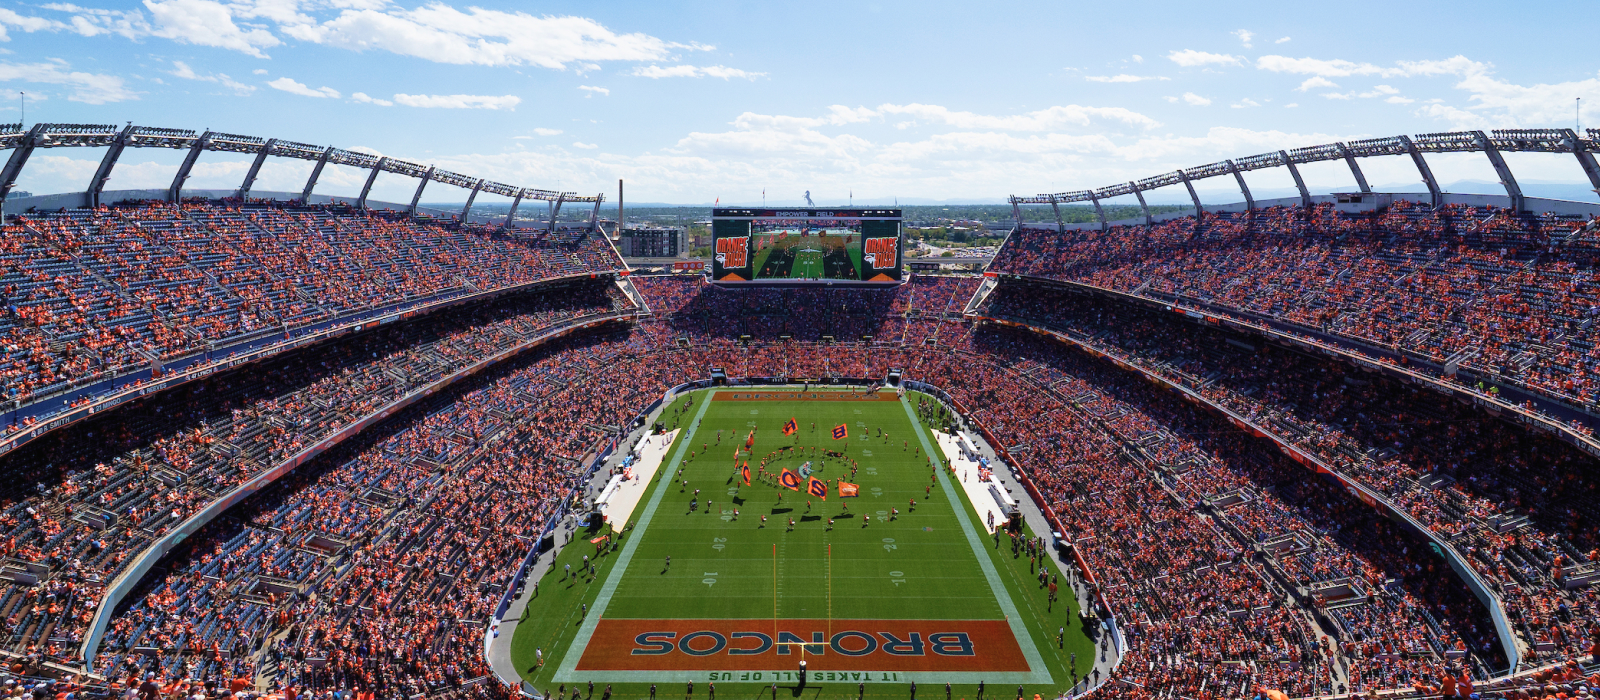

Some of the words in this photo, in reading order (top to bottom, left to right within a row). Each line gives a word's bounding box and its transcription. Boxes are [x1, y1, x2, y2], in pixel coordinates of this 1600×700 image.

[717, 237, 748, 253] ORANGE
[866, 237, 897, 253] ORANGE
[724, 252, 746, 268] RUSH
[874, 252, 895, 268] RUSH
[198, 368, 212, 377] LYNCH
[146, 383, 166, 394] REEVES
[102, 398, 120, 408] MINGO
[1485, 400, 1502, 412] NALEN
[50, 417, 70, 429] SMITH
[1534, 418, 1556, 434] SHARPE
[712, 538, 727, 550] 20
[882, 538, 898, 550] 20
[702, 572, 718, 584] 10
[890, 571, 906, 584] 10
[630, 630, 976, 656] BRONCOS
[709, 672, 732, 681] US
[740, 672, 762, 681] OF
[814, 672, 872, 682] TAKES
[882, 672, 897, 682] IT
